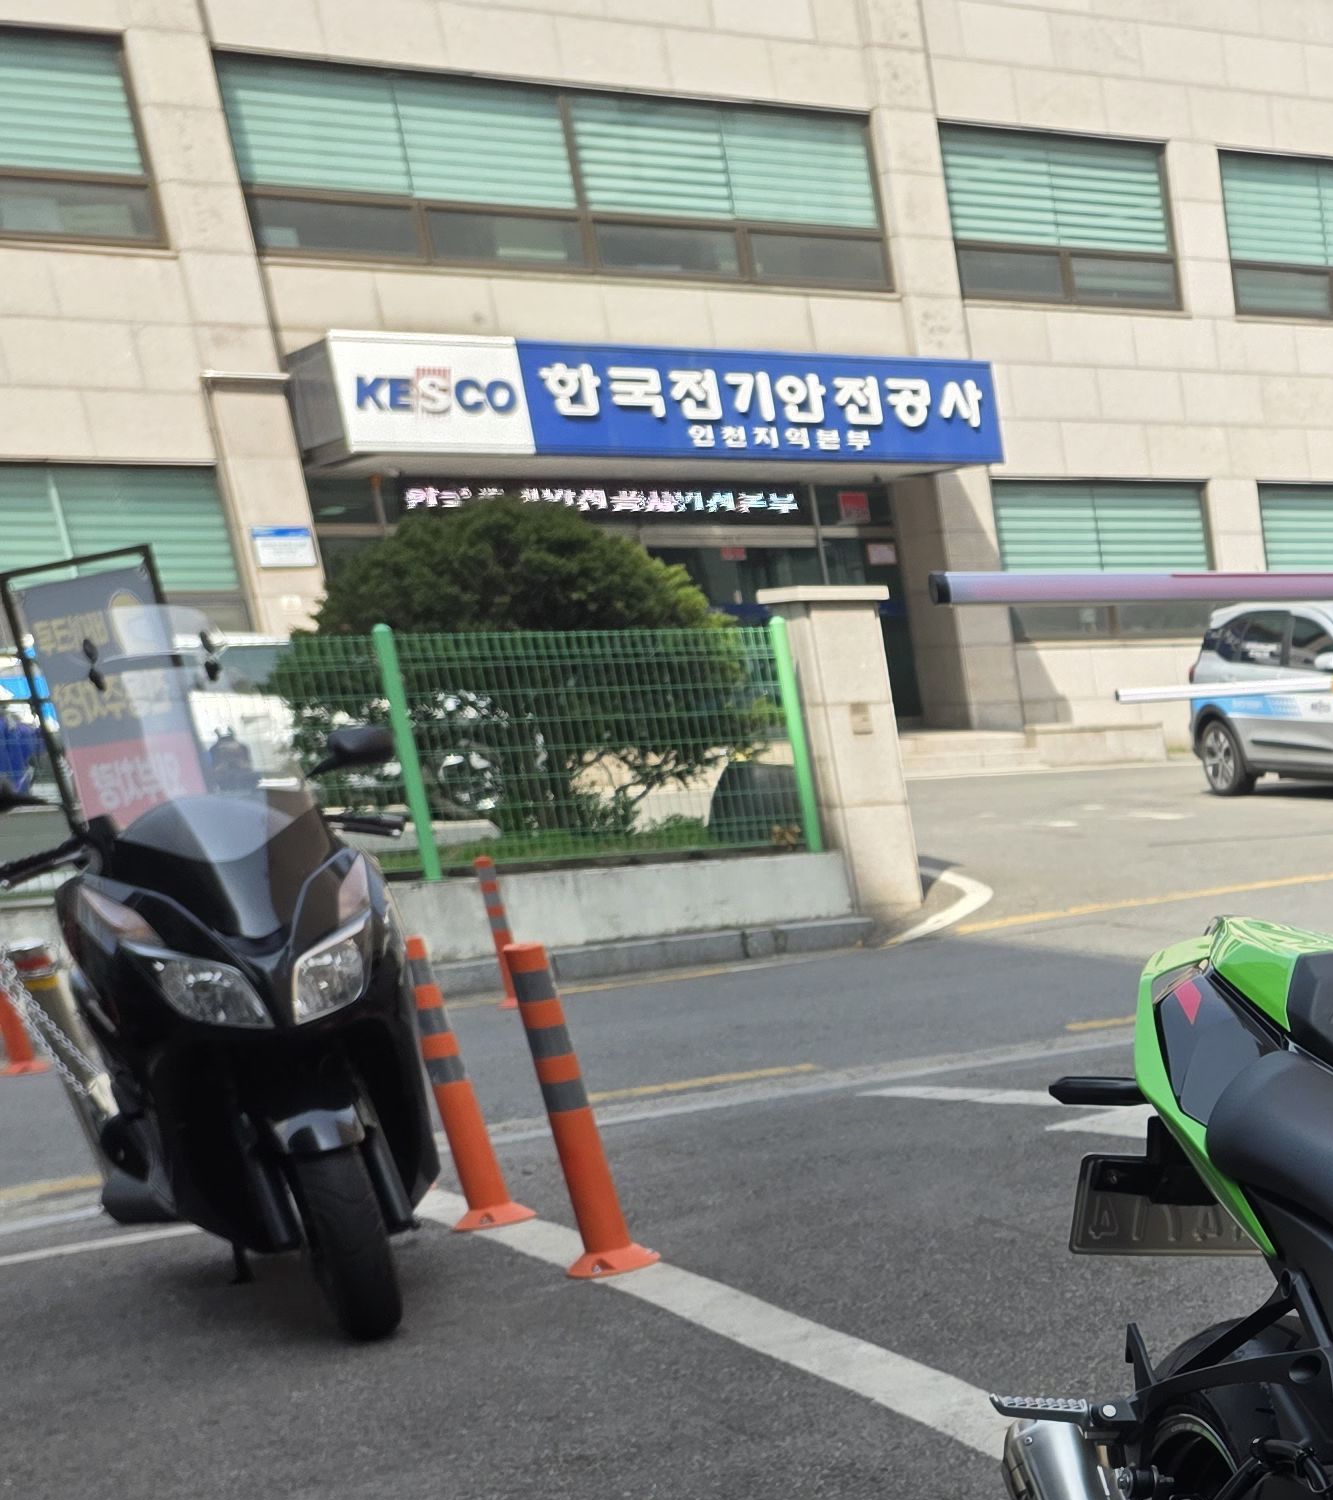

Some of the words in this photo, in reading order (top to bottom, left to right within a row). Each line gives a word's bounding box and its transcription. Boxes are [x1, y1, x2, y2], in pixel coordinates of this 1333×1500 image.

[355, 367, 518, 415] KESCO
[537, 362, 983, 428] 한국전기안전공사
[688, 425, 871, 451] 인천지역본부
